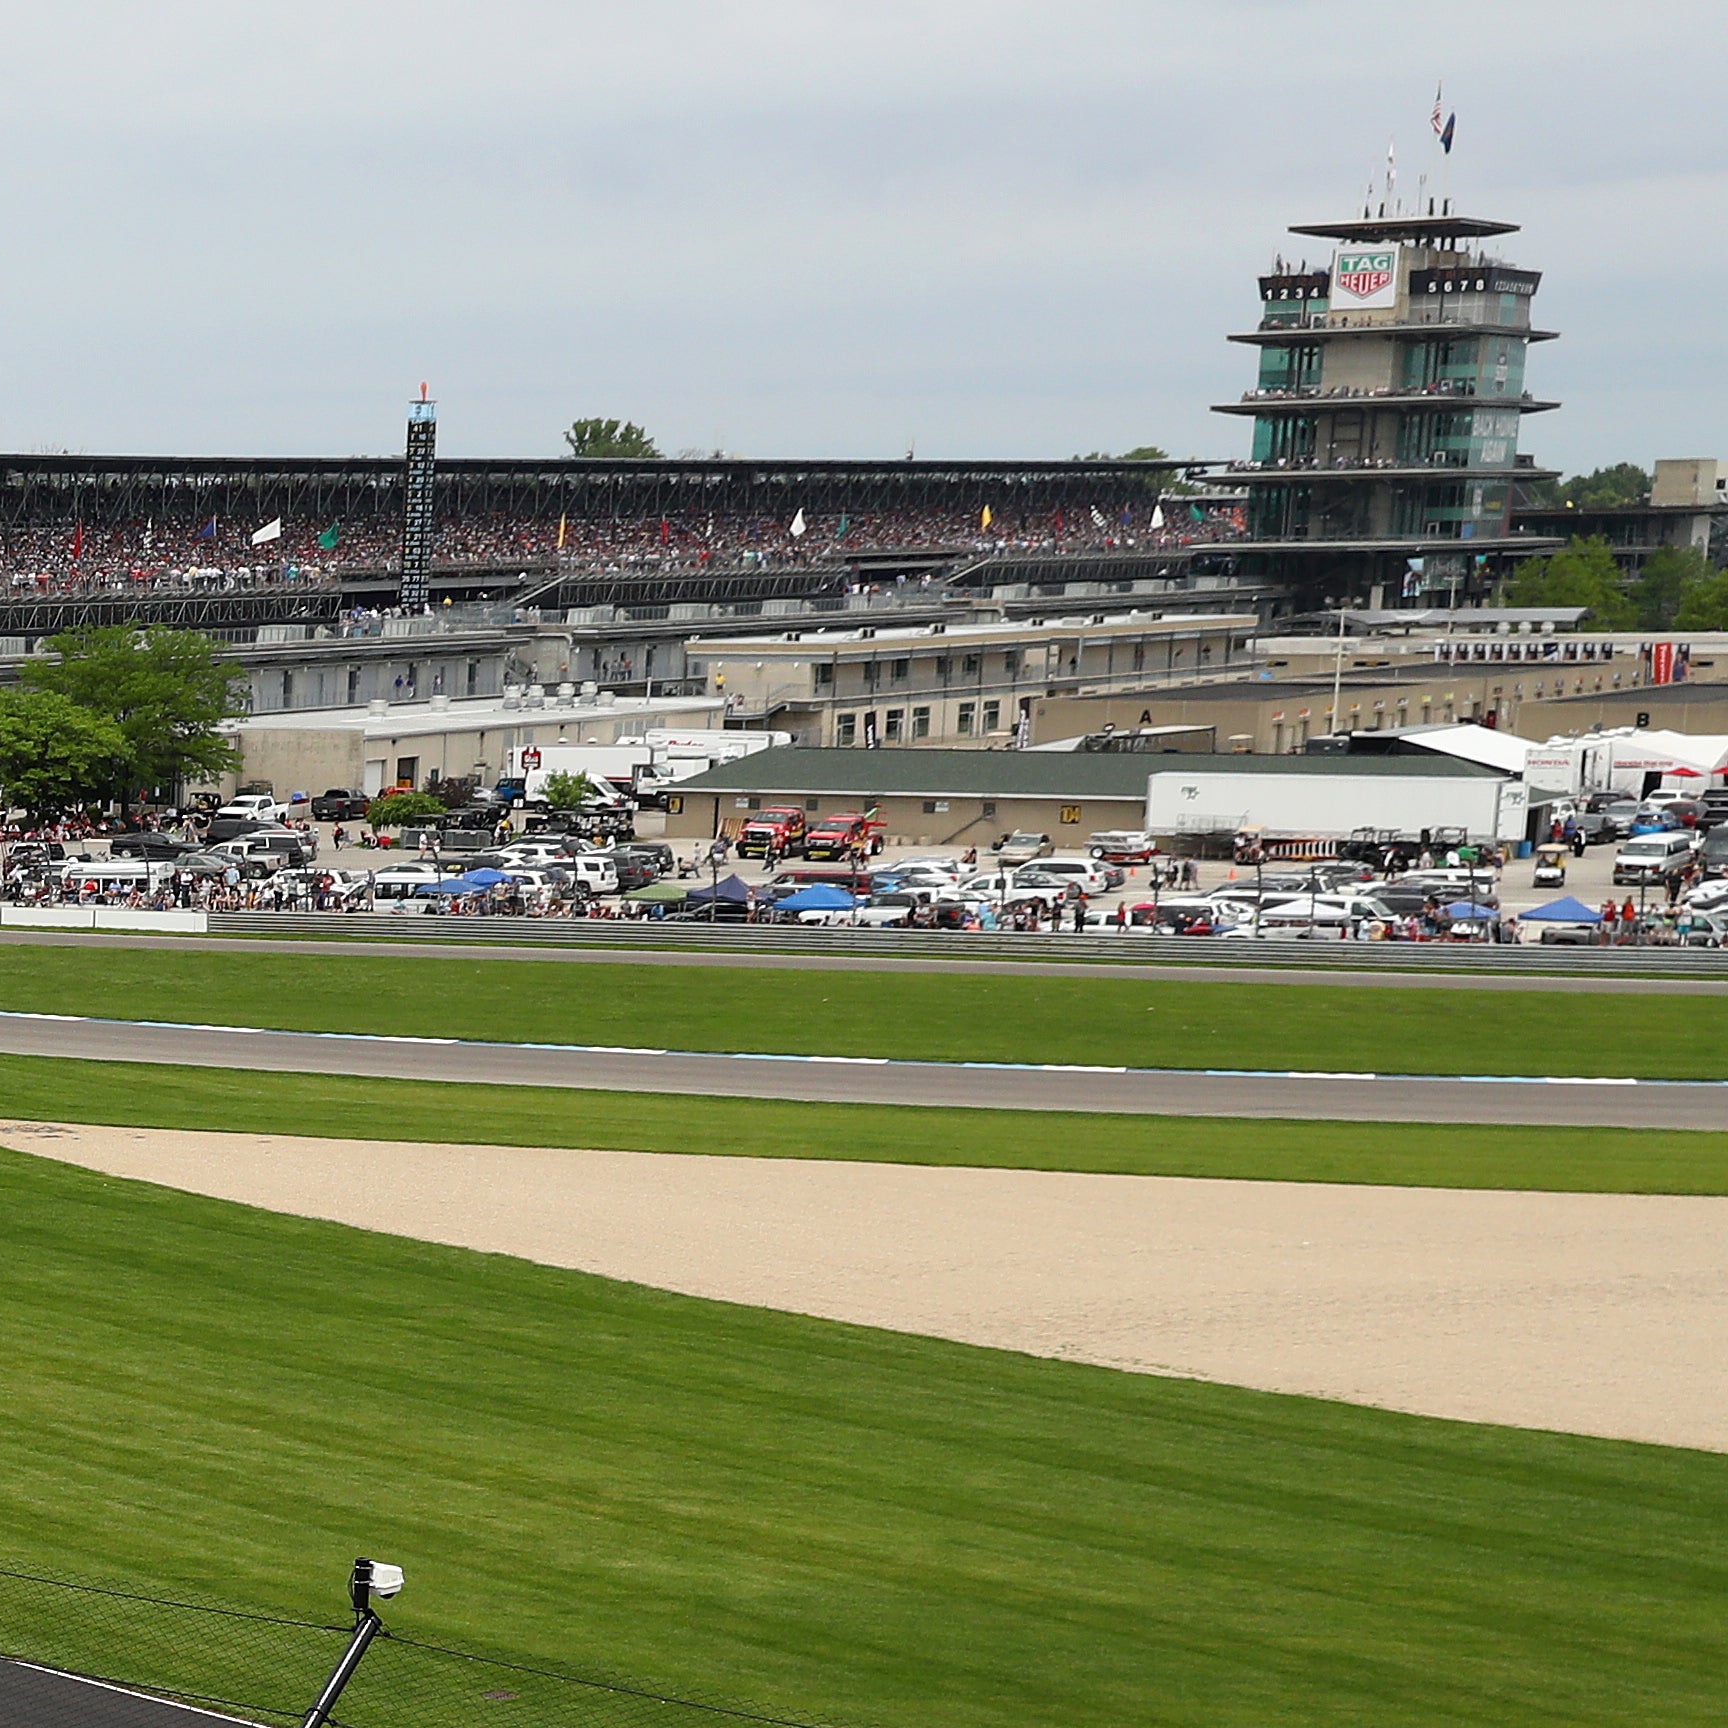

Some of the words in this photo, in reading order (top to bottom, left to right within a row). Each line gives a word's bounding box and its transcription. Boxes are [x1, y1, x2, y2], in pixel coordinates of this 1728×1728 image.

[1344, 257, 1388, 271] TAG
[1339, 273, 1388, 295] HEUER
[1428, 281, 1437, 293] 5
[1444, 280, 1453, 292] 6
[1460, 280, 1469, 292] 7
[1475, 279, 1484, 291] 8
[1265, 288, 1273, 300] 1
[1280, 288, 1289, 300] 2
[1295, 287, 1304, 299] 3
[1309, 287, 1319, 298] 4
[1140, 709, 1151, 724] A
[1636, 712, 1650, 727] B
